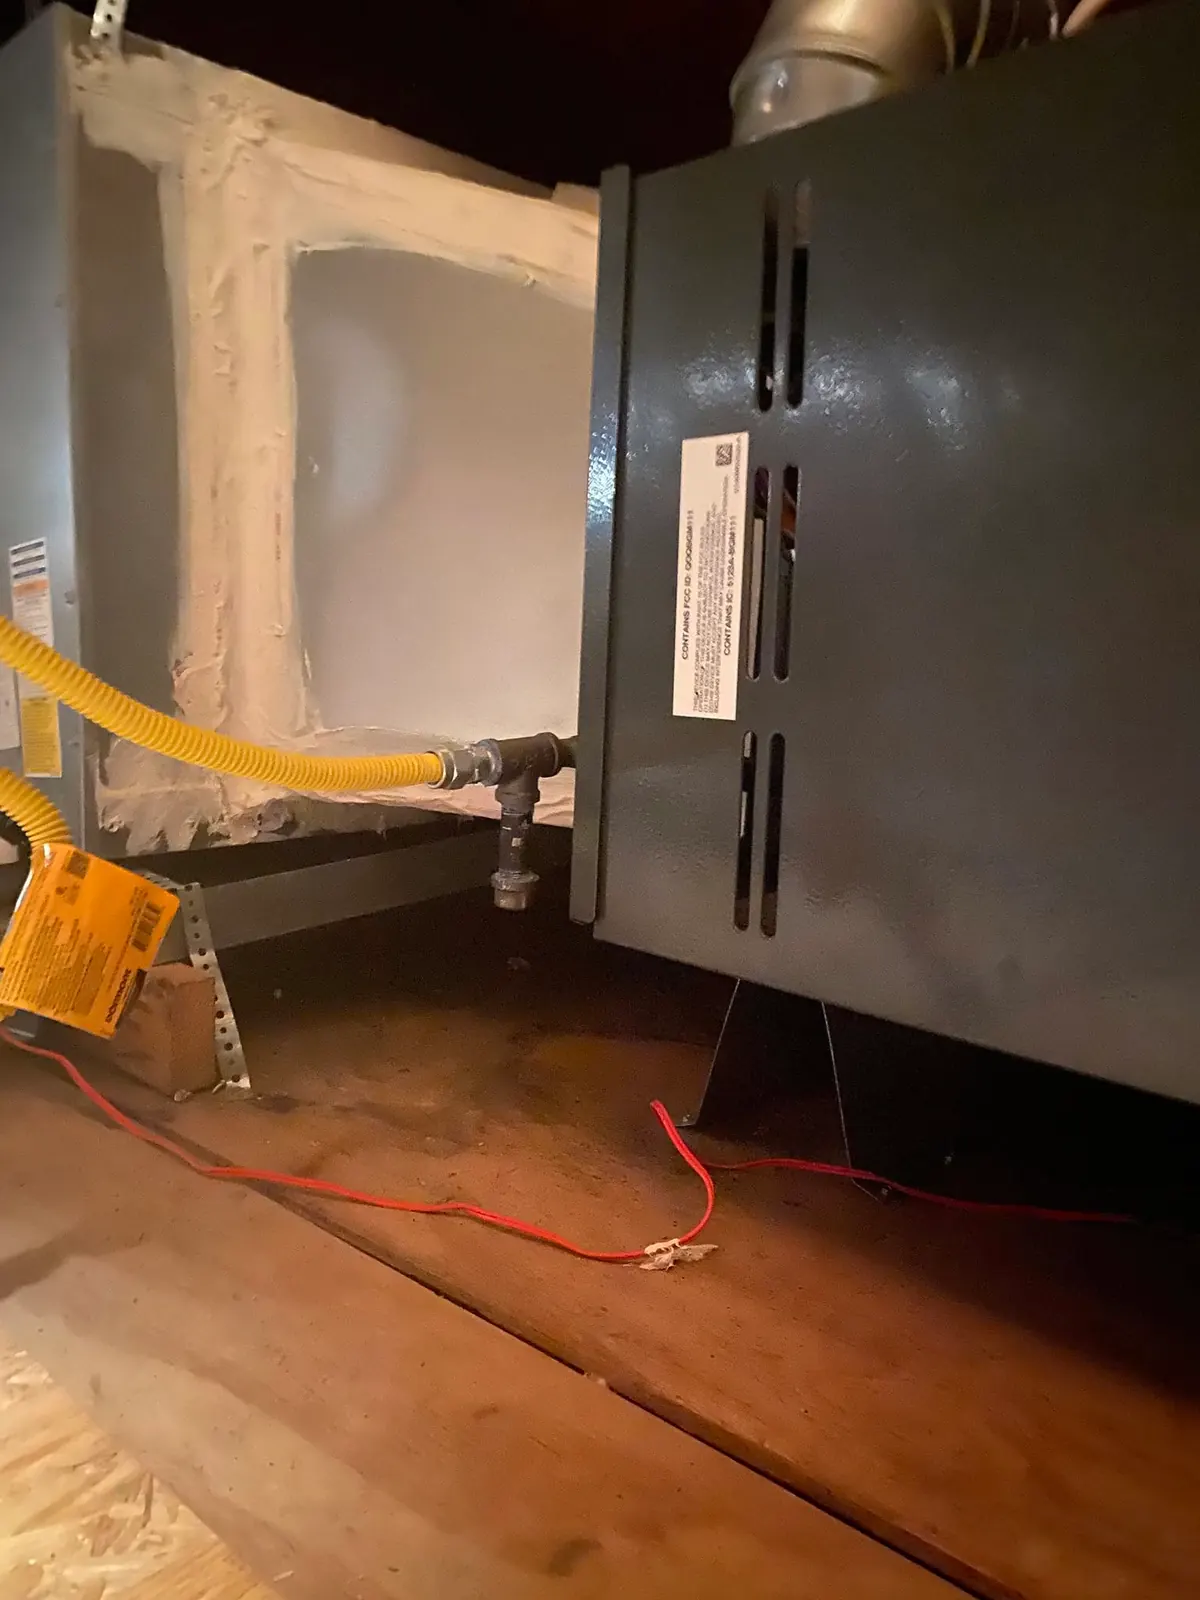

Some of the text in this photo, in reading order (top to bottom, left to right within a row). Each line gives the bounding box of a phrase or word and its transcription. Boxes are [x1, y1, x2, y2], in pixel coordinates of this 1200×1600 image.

[725, 589, 733, 602] IC:
[681, 611, 689, 659] CONTAINS
[723, 605, 732, 655] CONTAINS
